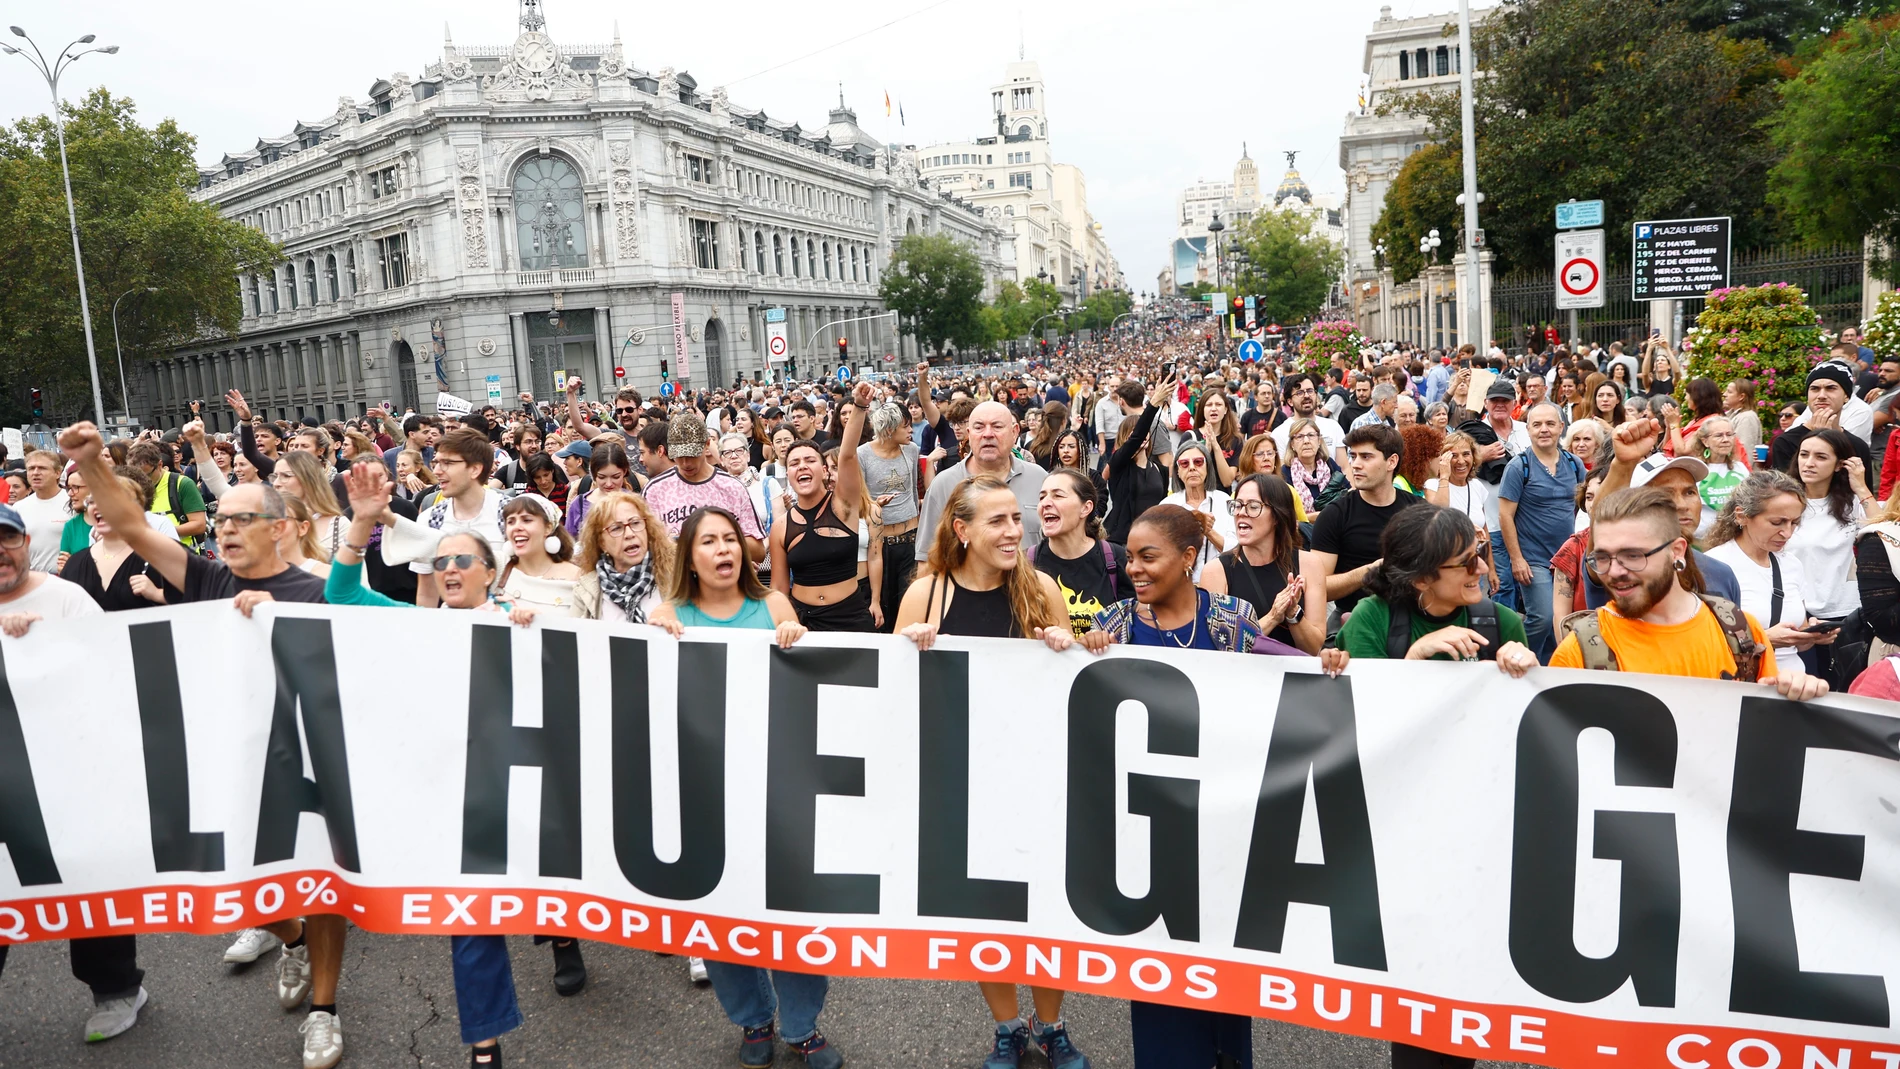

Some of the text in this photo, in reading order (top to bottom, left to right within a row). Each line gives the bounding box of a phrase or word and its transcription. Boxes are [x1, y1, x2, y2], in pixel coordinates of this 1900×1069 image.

[1654, 226, 1687, 235] PLAZAS
[1689, 224, 1719, 234] LIBRES
[1667, 240, 1696, 248] MAYOR
[1637, 250, 1654, 258] 195
[1682, 248, 1717, 256] CARMEN
[1678, 257, 1712, 265] ORIENTE
[1654, 267, 1683, 275] MERCD.
[1685, 265, 1718, 273] CEBADA
[1654, 276, 1684, 284] MERCD.
[1685, 273, 1723, 282] S.ANTÓN
[1654, 285, 1693, 293] HOSPITAL
[673, 302, 681, 332] FLEXIBLE
[675, 333, 683, 356] PLANO
[128, 616, 361, 873] LA
[460, 624, 1388, 972] HUELGA
[1509, 683, 1900, 1028] GE
[0, 891, 194, 941] QUILER
[212, 876, 338, 924] 50%
[401, 893, 887, 968] EXPROPIACIÓN
[927, 936, 1219, 1000] FONDOS
[1259, 973, 1547, 1054] BUITRE
